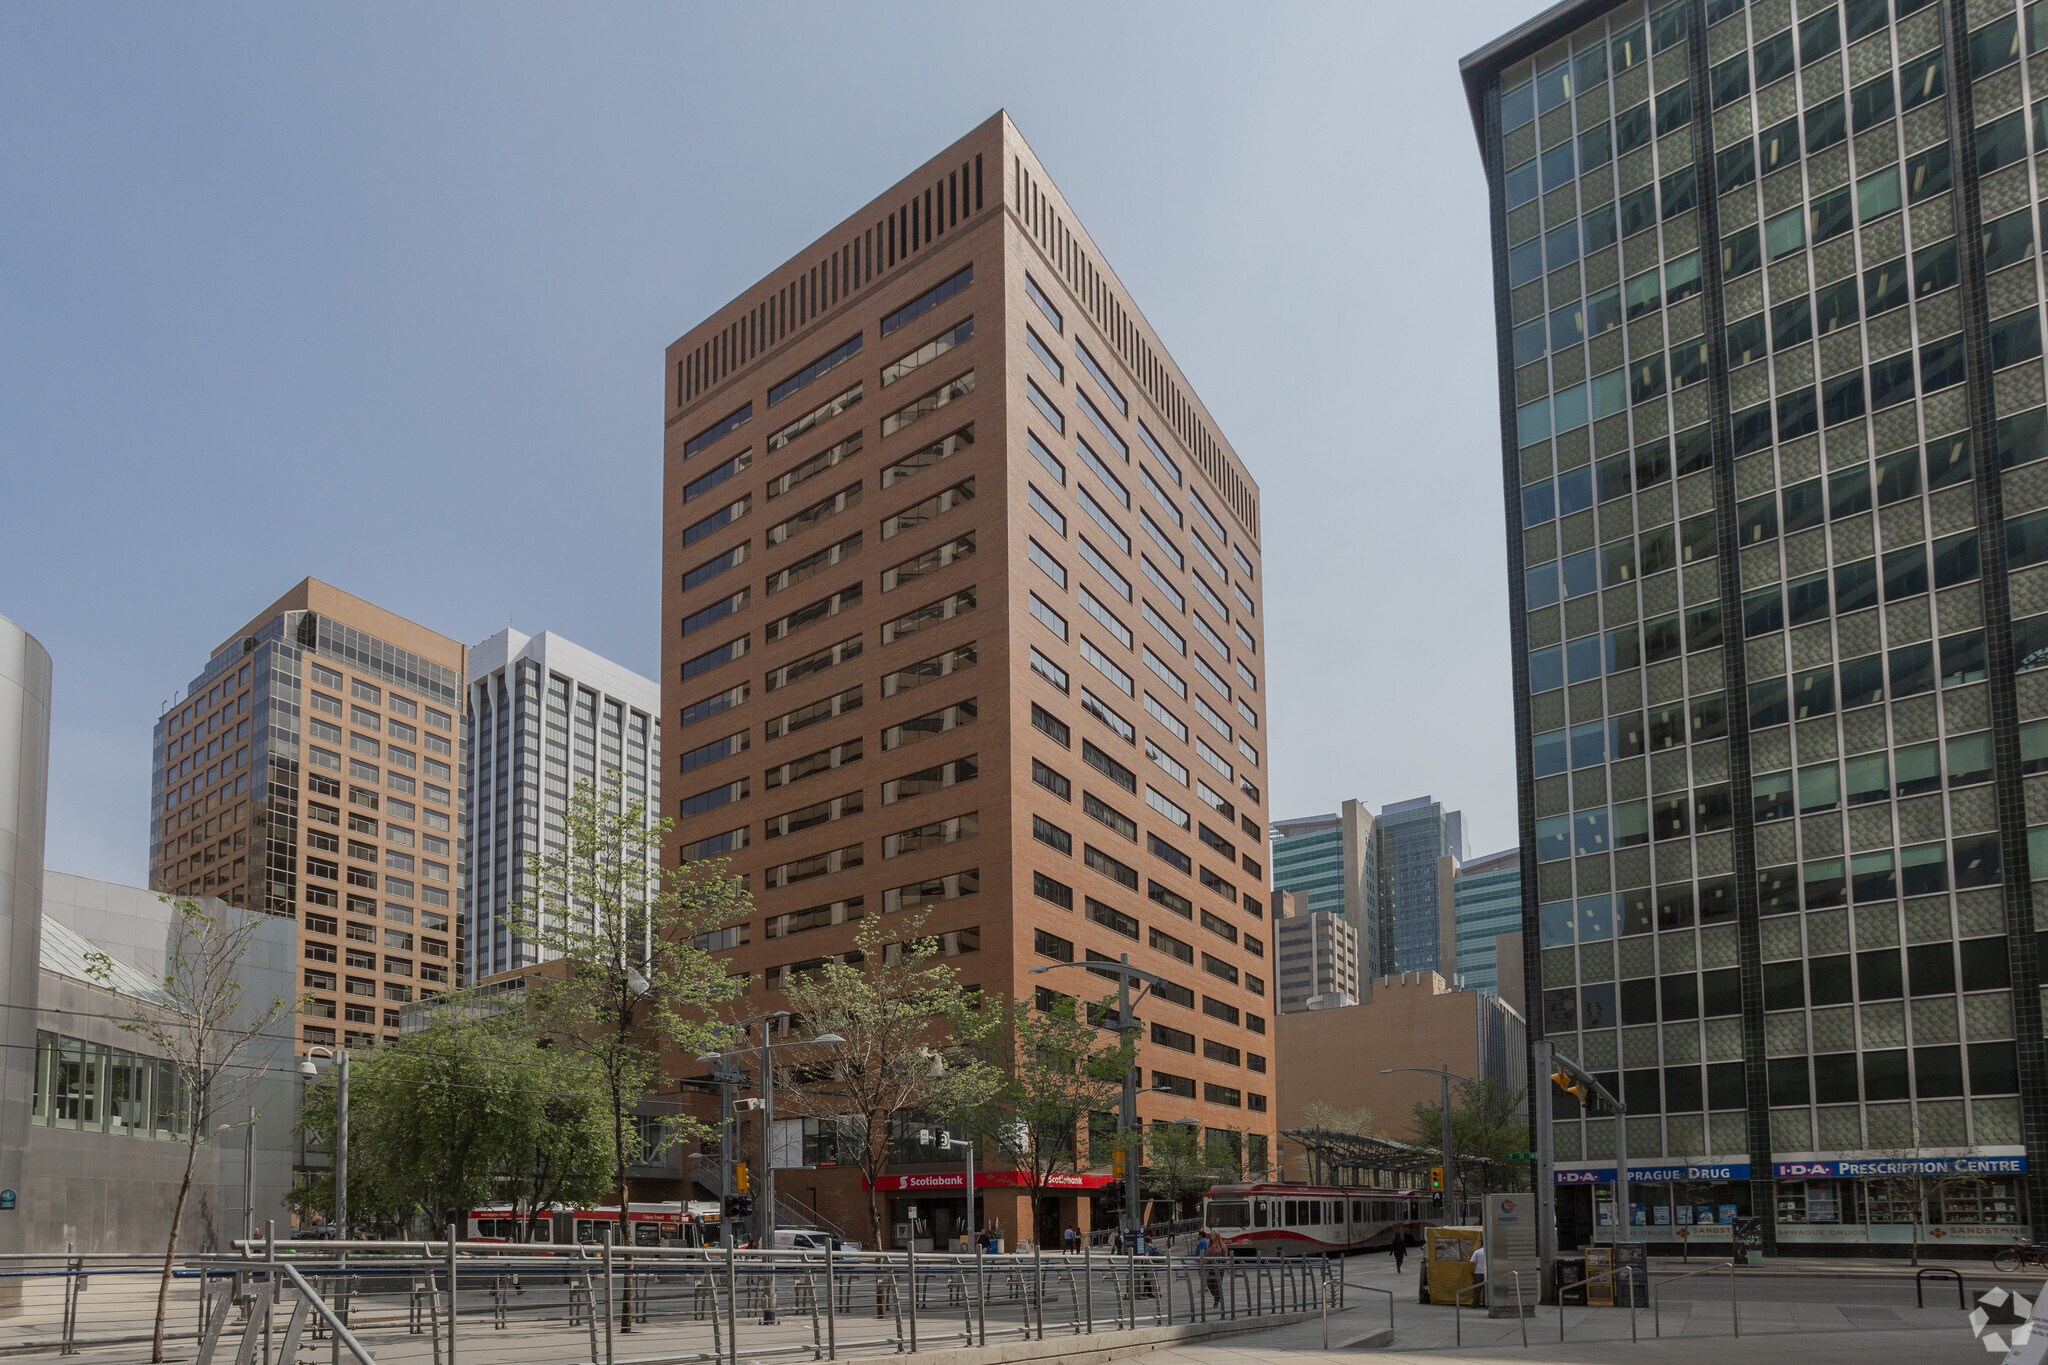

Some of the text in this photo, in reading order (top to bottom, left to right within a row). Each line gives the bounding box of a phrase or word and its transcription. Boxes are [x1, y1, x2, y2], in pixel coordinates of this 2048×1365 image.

[1627, 1167, 1730, 1181] PRAGUE DRUG
[1839, 1159, 2021, 1176] PRESCRIPTION CENTRE
[910, 1175, 963, 1187] Scotiabank
[1692, 1226, 1732, 1234] SANDST
